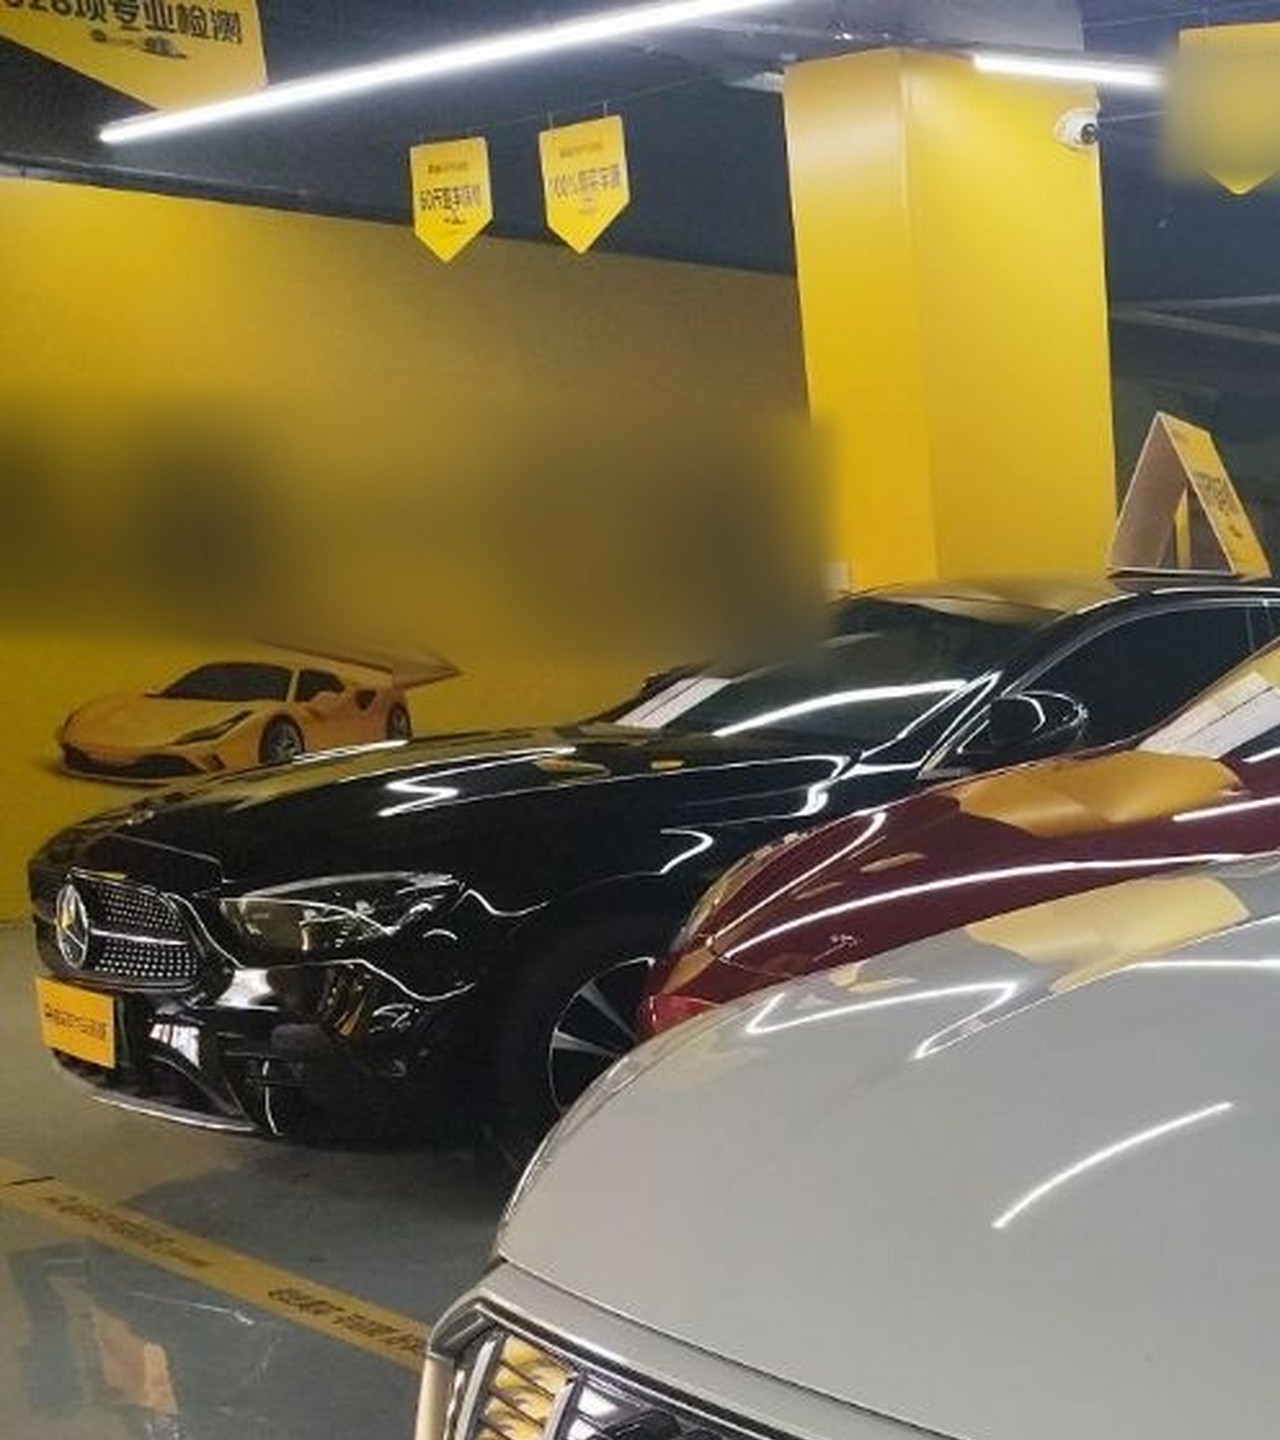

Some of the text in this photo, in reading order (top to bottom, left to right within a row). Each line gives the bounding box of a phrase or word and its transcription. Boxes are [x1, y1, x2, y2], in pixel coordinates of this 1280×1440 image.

[7, 0, 243, 44] 8项专业检测
